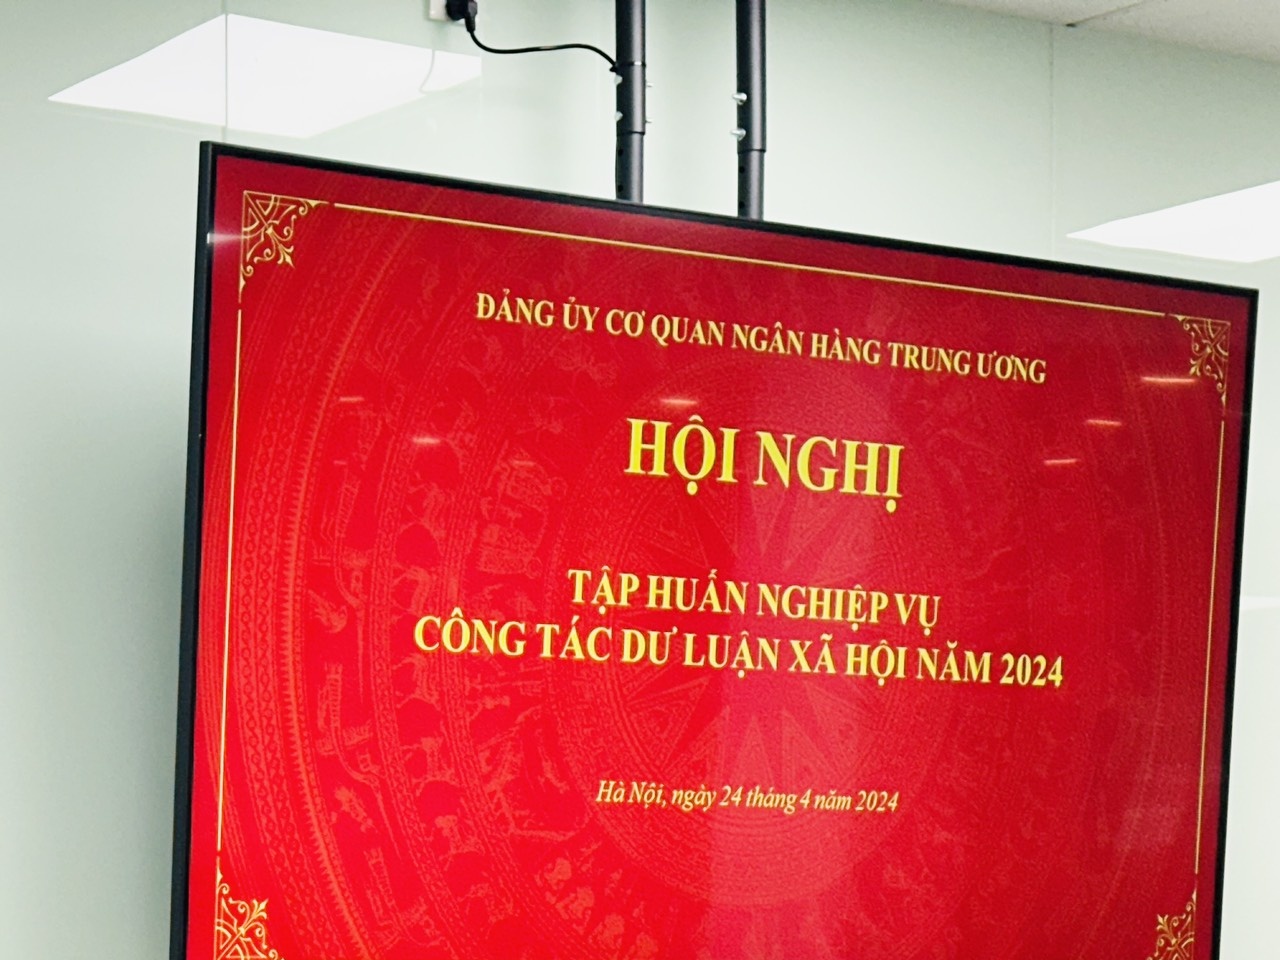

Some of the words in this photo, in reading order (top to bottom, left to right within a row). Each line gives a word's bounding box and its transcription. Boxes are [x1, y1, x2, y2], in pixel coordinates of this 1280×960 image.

[475, 287, 556, 328] ĐẢNG
[562, 296, 601, 333] ỦY
[604, 308, 646, 338] CƠ
[649, 314, 726, 348] QUAN
[730, 320, 805, 356] NGÂN
[809, 327, 882, 365] HÀNG
[887, 341, 972, 376] TRUNG
[976, 350, 1047, 384] ƯƠNG
[623, 413, 741, 496] HỘI
[752, 430, 906, 514] NGHỊ
[566, 564, 641, 616] TẬP
[645, 568, 750, 615] HUẤN
[756, 582, 890, 632] NGHIỆP
[893, 592, 942, 637] VỤ
[413, 606, 527, 657] CÔNG
[534, 614, 613, 663] TÁC
[619, 625, 679, 666] DƯ
[682, 630, 781, 679] LUẬN
[787, 633, 837, 675] XÃ
[843, 639, 909, 687] HỘI
[915, 639, 993, 684] NĂM
[999, 652, 1064, 689] 2024
[594, 779, 627, 804] Hà
[626, 780, 667, 810] Nội,
[670, 783, 718, 813] ngày
[718, 784, 744, 807] 24
[745, 784, 799, 816] tháng
[798, 788, 812, 810] 4
[813, 789, 853, 811] năm
[854, 789, 900, 813] 2024
